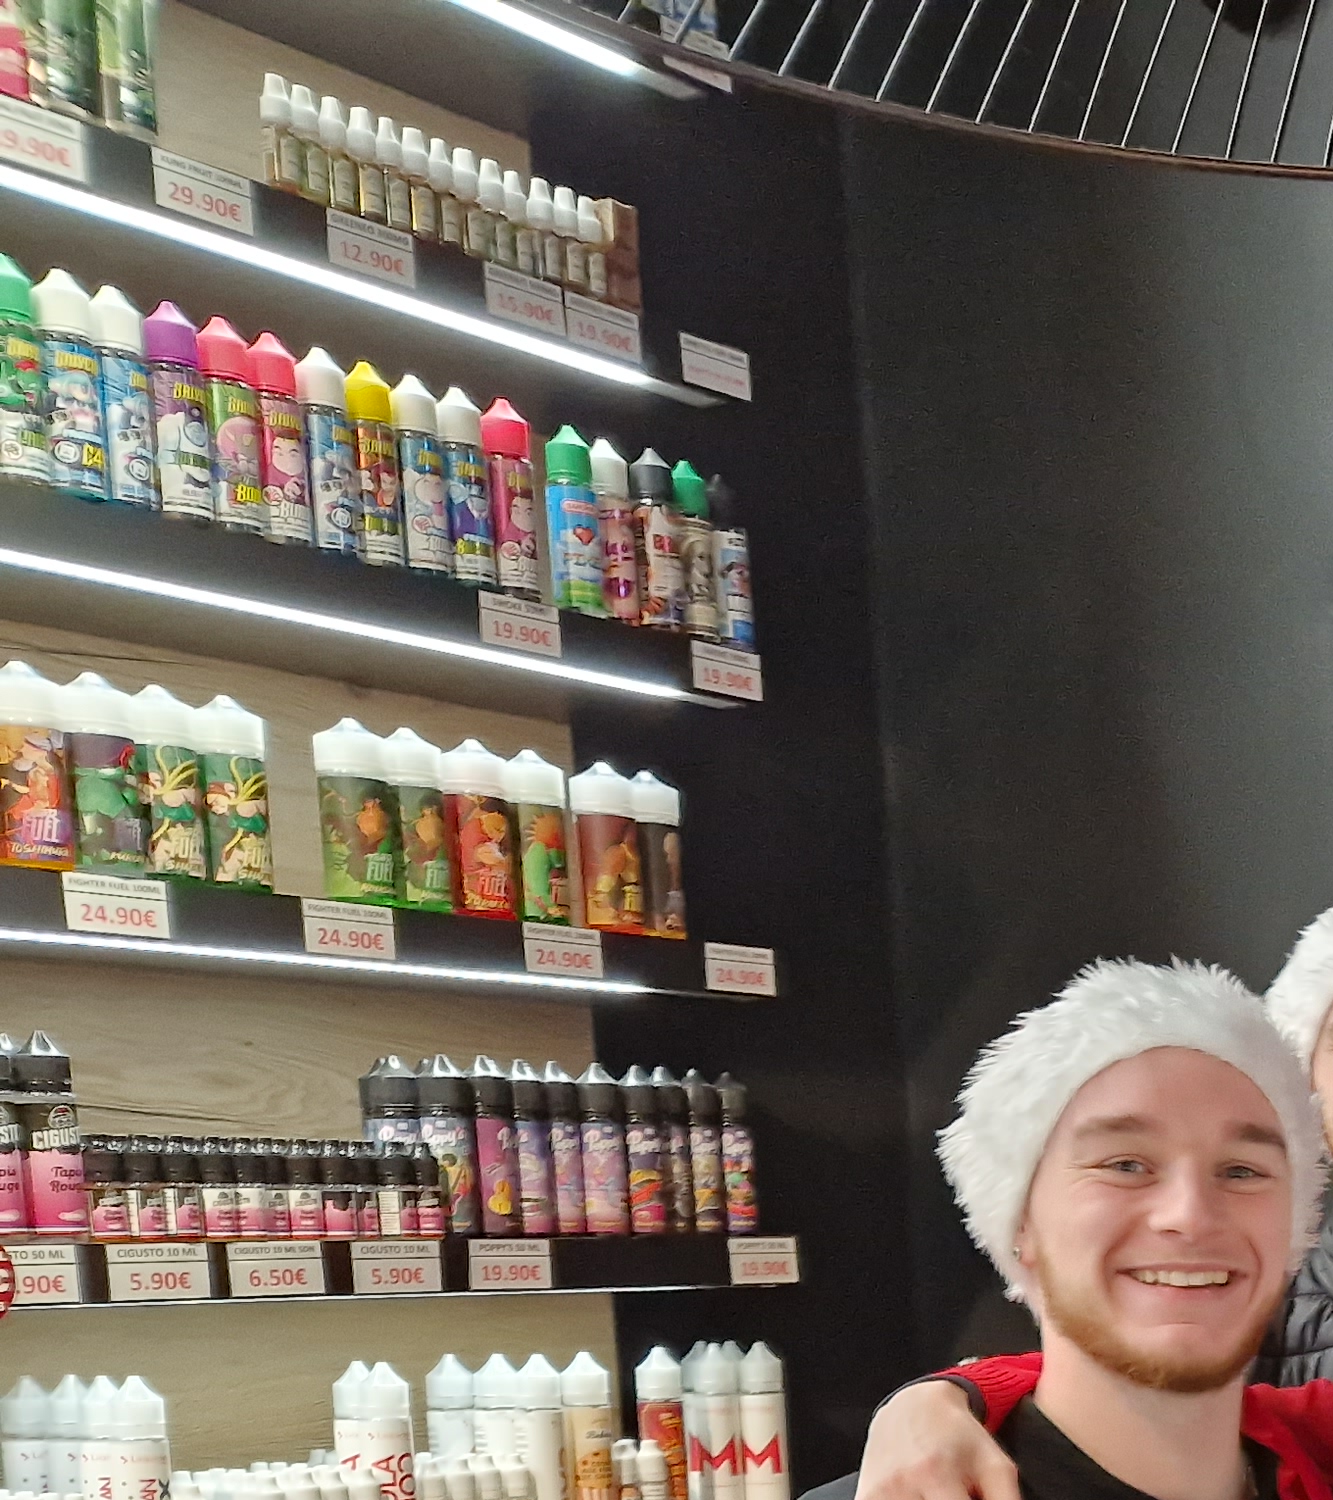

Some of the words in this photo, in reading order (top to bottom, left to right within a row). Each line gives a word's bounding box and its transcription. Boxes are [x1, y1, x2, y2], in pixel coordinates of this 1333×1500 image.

[167, 181, 242, 222] 29.90€
[340, 240, 405, 278] 12.90€
[492, 619, 552, 648] 19.90€
[68, 877, 107, 889] FIGHTER
[108, 880, 132, 892] FUEL
[80, 903, 158, 929] 24.90€
[317, 927, 385, 951] 24.90€
[536, 948, 594, 970] 24.90€
[31, 1249, 46, 1260] 50
[48, 1249, 66, 1260] ML
[117, 1247, 164, 1259] CIGUSTO
[166, 1246, 180, 1258] 10
[181, 1246, 198, 1257] ML
[233, 1246, 271, 1256] CIGUSTO
[360, 1244, 401, 1256] CIGUSTO
[129, 1271, 192, 1292] 5.90€
[249, 1267, 308, 1288] 6.50€
[371, 1267, 425, 1286] 5.90€
[481, 1263, 542, 1283] 19.90€
